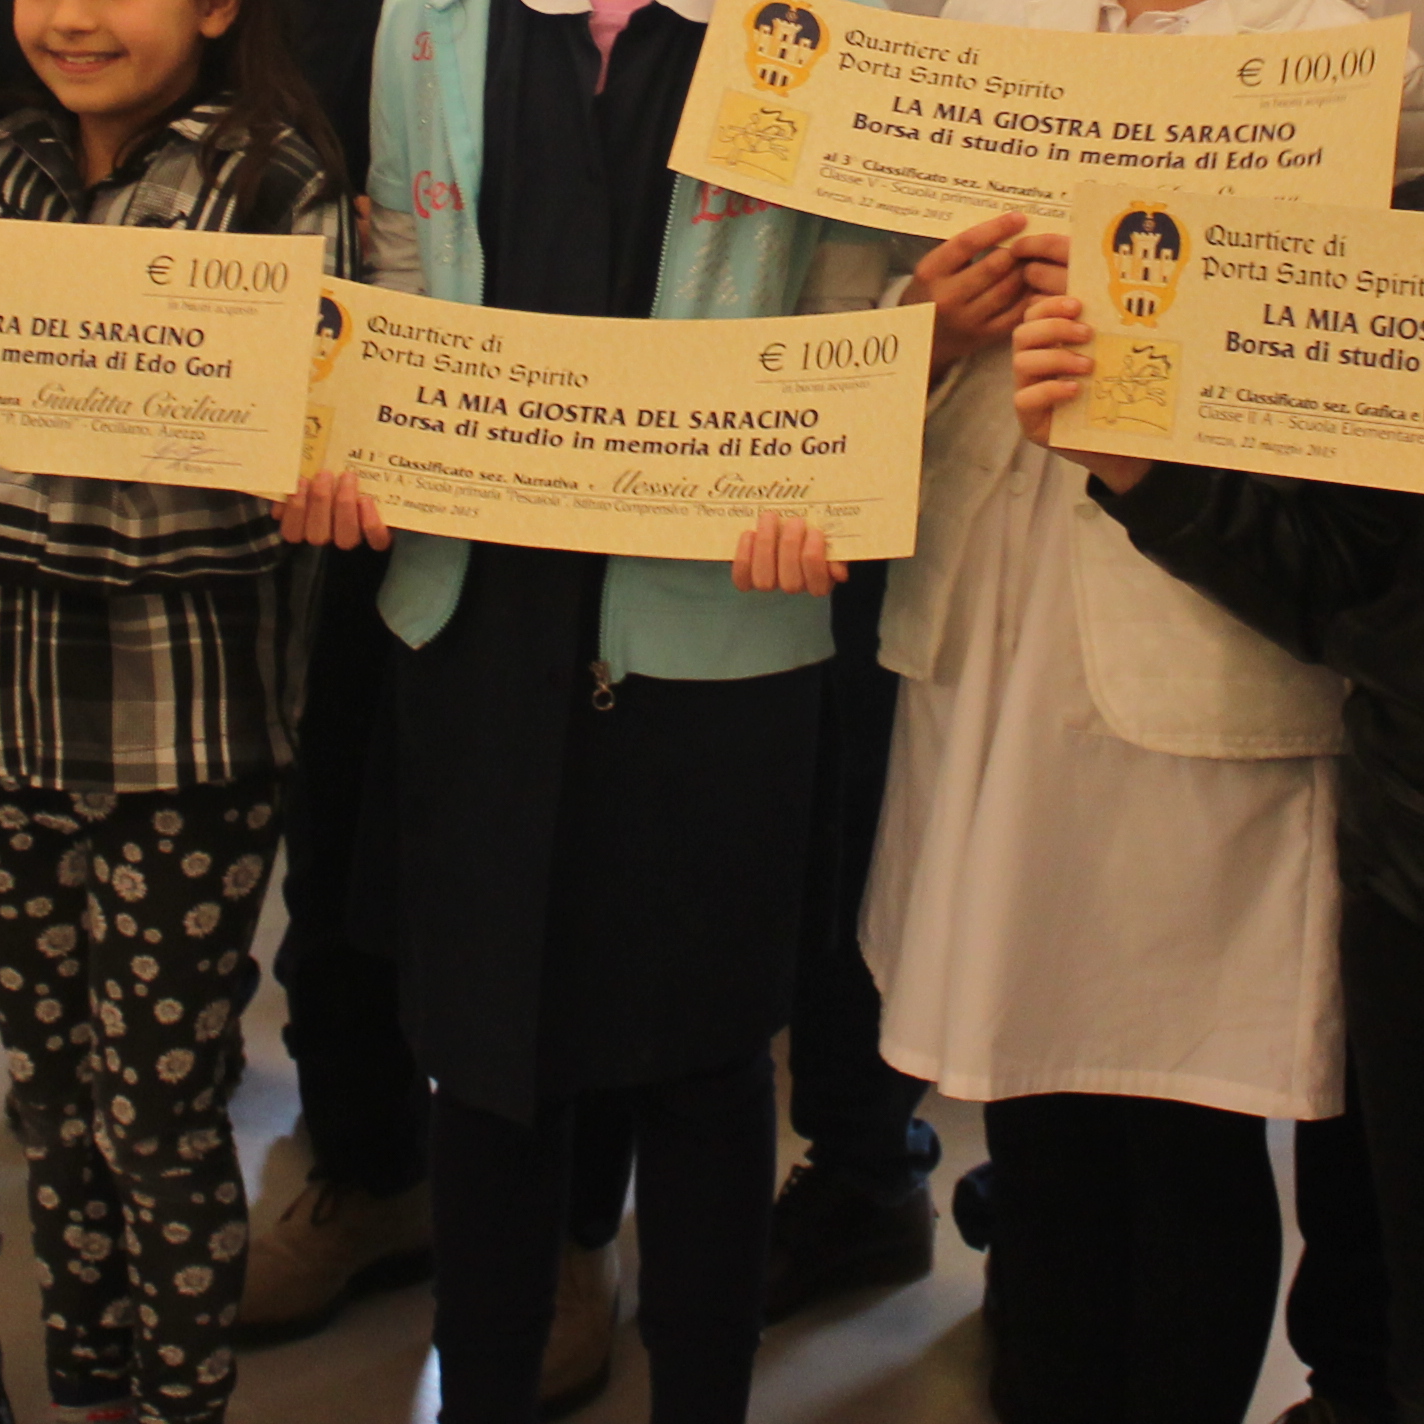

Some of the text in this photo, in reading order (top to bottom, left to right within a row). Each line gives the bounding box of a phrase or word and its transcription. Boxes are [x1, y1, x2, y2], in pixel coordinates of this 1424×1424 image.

[845, 30, 980, 65] Quartiere di
[838, 52, 1065, 100] Porta Santo Spirito
[1237, 57, 1265, 87] €
[893, 96, 1296, 143] LA MIA GIOSTRA DEL SARACINO
[853, 112, 1324, 170] Borsa di studio in memoria di Edo Gori
[1205, 225, 1346, 257] Quartiere di
[146, 255, 175, 285] €
[1202, 256, 1268, 281] Porta
[1277, 262, 1347, 290] Santo
[31, 318, 69, 338] DEL
[78, 320, 205, 348] SARACINO
[367, 315, 504, 353] Quartiere di
[1264, 304, 1295, 328] LA
[1306, 308, 1358, 334] MIA
[2, 348, 97, 369] memoria
[106, 351, 126, 370] di
[134, 353, 176, 374] Edo
[186, 357, 232, 379] Gori
[361, 340, 589, 388] Porta Santo Spirito
[759, 342, 786, 372] €
[1226, 330, 1295, 360] Borsa
[1305, 340, 1330, 362] di
[1338, 347, 1420, 372] studio
[32, 381, 132, 414] Giuditta
[416, 386, 819, 429] LA MIA GIOSTRA DEL SARACINO
[1200, 386, 1212, 398] al
[1236, 388, 1318, 410] Classificato
[1355, 402, 1406, 421] Grafica
[1411, 411, 1419, 421] e
[378, 405, 847, 456] Borsa di studio in memoria di Edo Gori
[388, 454, 474, 478] Classificato
[513, 473, 578, 490] Narrativa
